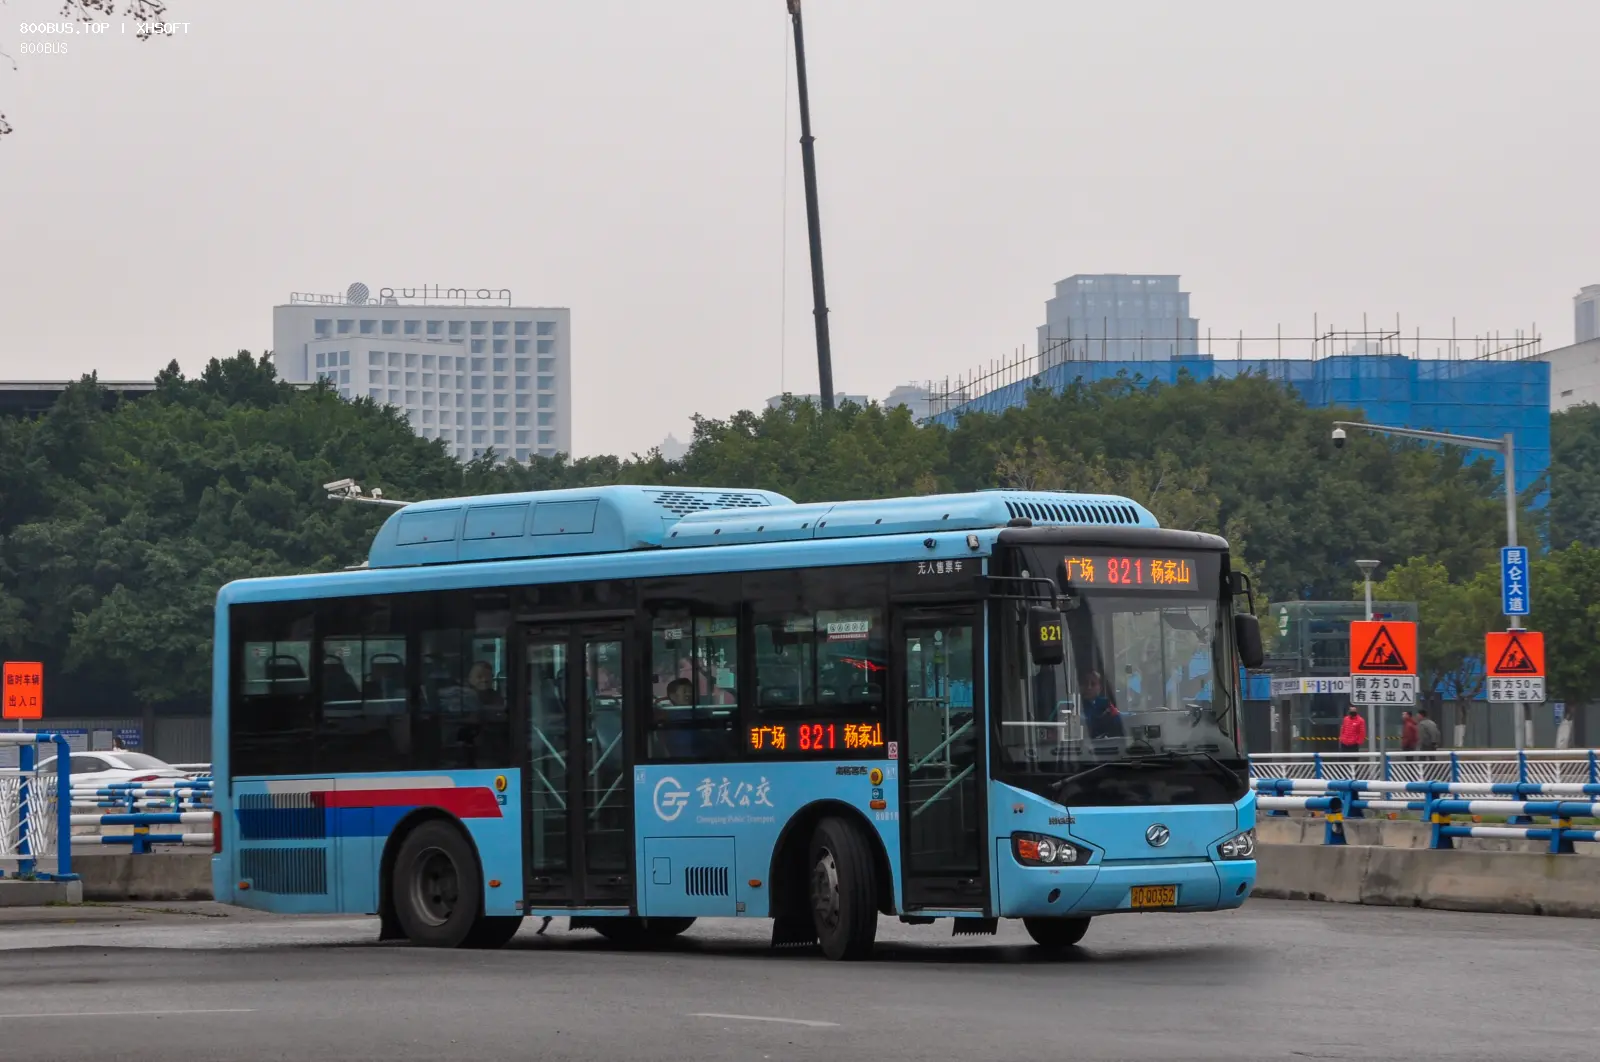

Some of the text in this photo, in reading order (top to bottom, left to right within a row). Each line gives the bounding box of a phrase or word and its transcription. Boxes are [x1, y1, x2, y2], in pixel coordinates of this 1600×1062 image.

[380, 283, 511, 307] pullman
[917, 560, 963, 575] 无人售票车
[1107, 557, 1143, 584] 821
[1150, 559, 1190, 585] 杨家山
[1506, 549, 1524, 612] 昆仑大道
[1040, 625, 1062, 641] 821
[6, 674, 40, 686] 临时车辆
[1332, 679, 1344, 691] 10
[1355, 677, 1412, 689] 前方50m
[1491, 679, 1541, 689] 前方50m
[8, 695, 37, 707] 出入口
[1355, 690, 1411, 702] 有车出入
[1491, 690, 1541, 700] 有车出入
[799, 723, 835, 750] 821
[843, 722, 884, 749] 杨家山
[696, 777, 774, 808] 重庆公交
